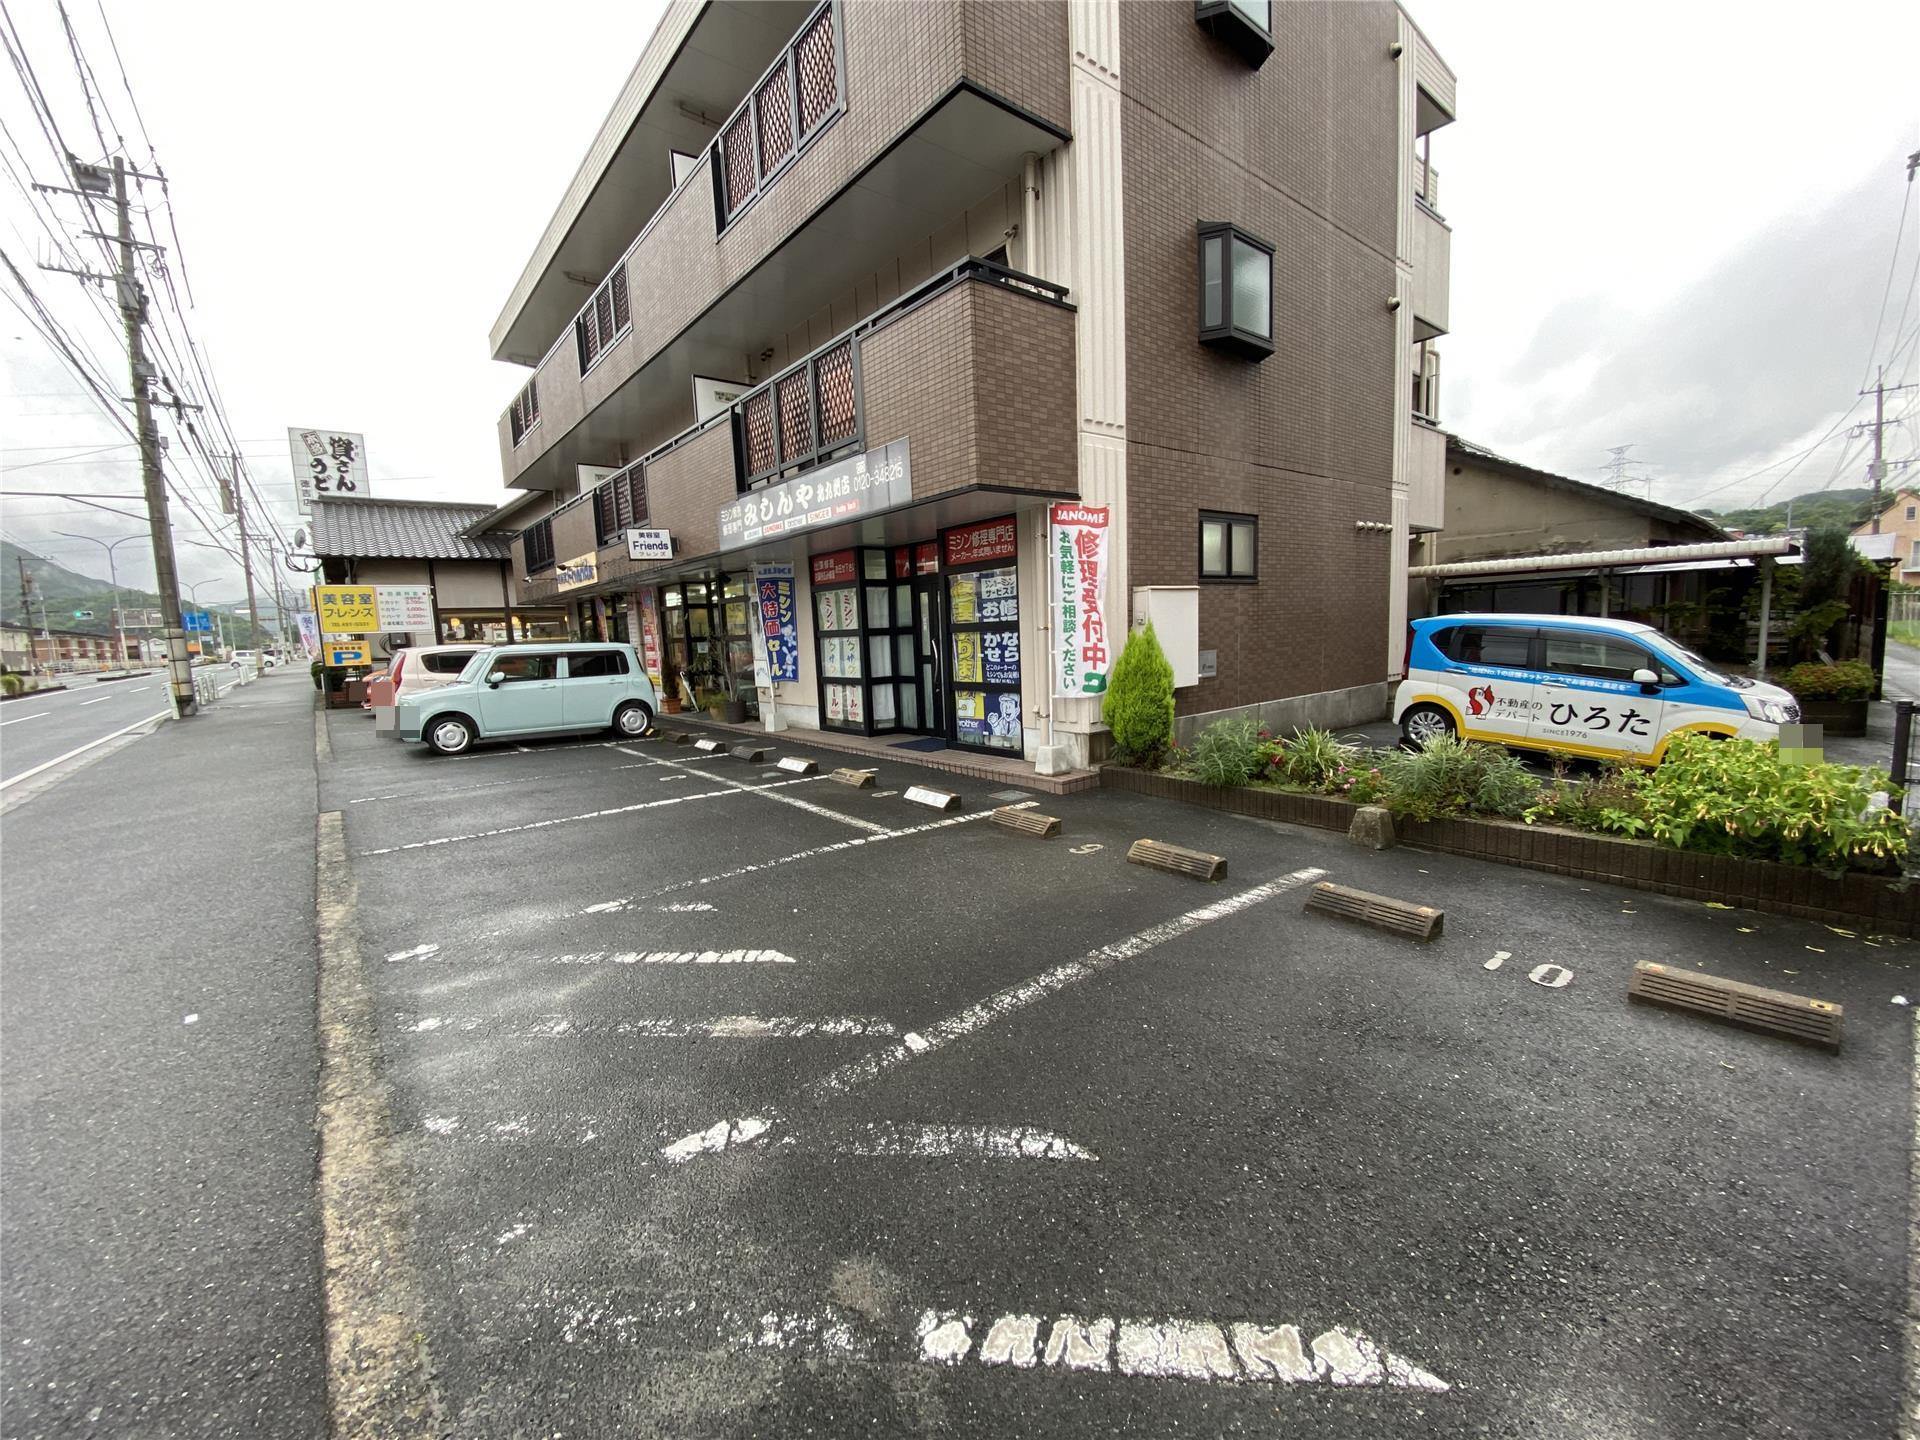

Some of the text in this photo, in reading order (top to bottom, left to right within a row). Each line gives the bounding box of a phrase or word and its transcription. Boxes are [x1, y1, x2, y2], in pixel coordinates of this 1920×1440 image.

[328, 436, 356, 492] 資さん
[1057, 509, 1105, 524] JANOME
[633, 540, 669, 551] Friends
[758, 567, 792, 576] JUKI
[322, 593, 373, 606] 美容室
[778, 582, 792, 623] ミシン
[1074, 529, 1107, 671] 修理受付中
[1059, 531, 1077, 690] お気軽にご相談ください
[761, 583, 783, 677] 大特価セール
[333, 651, 362, 664] P
[1497, 697, 1543, 711] 不動産の
[1495, 709, 1541, 722] デパート
[1550, 702, 1651, 736] ひろた
[1069, 843, 1105, 855] 9
